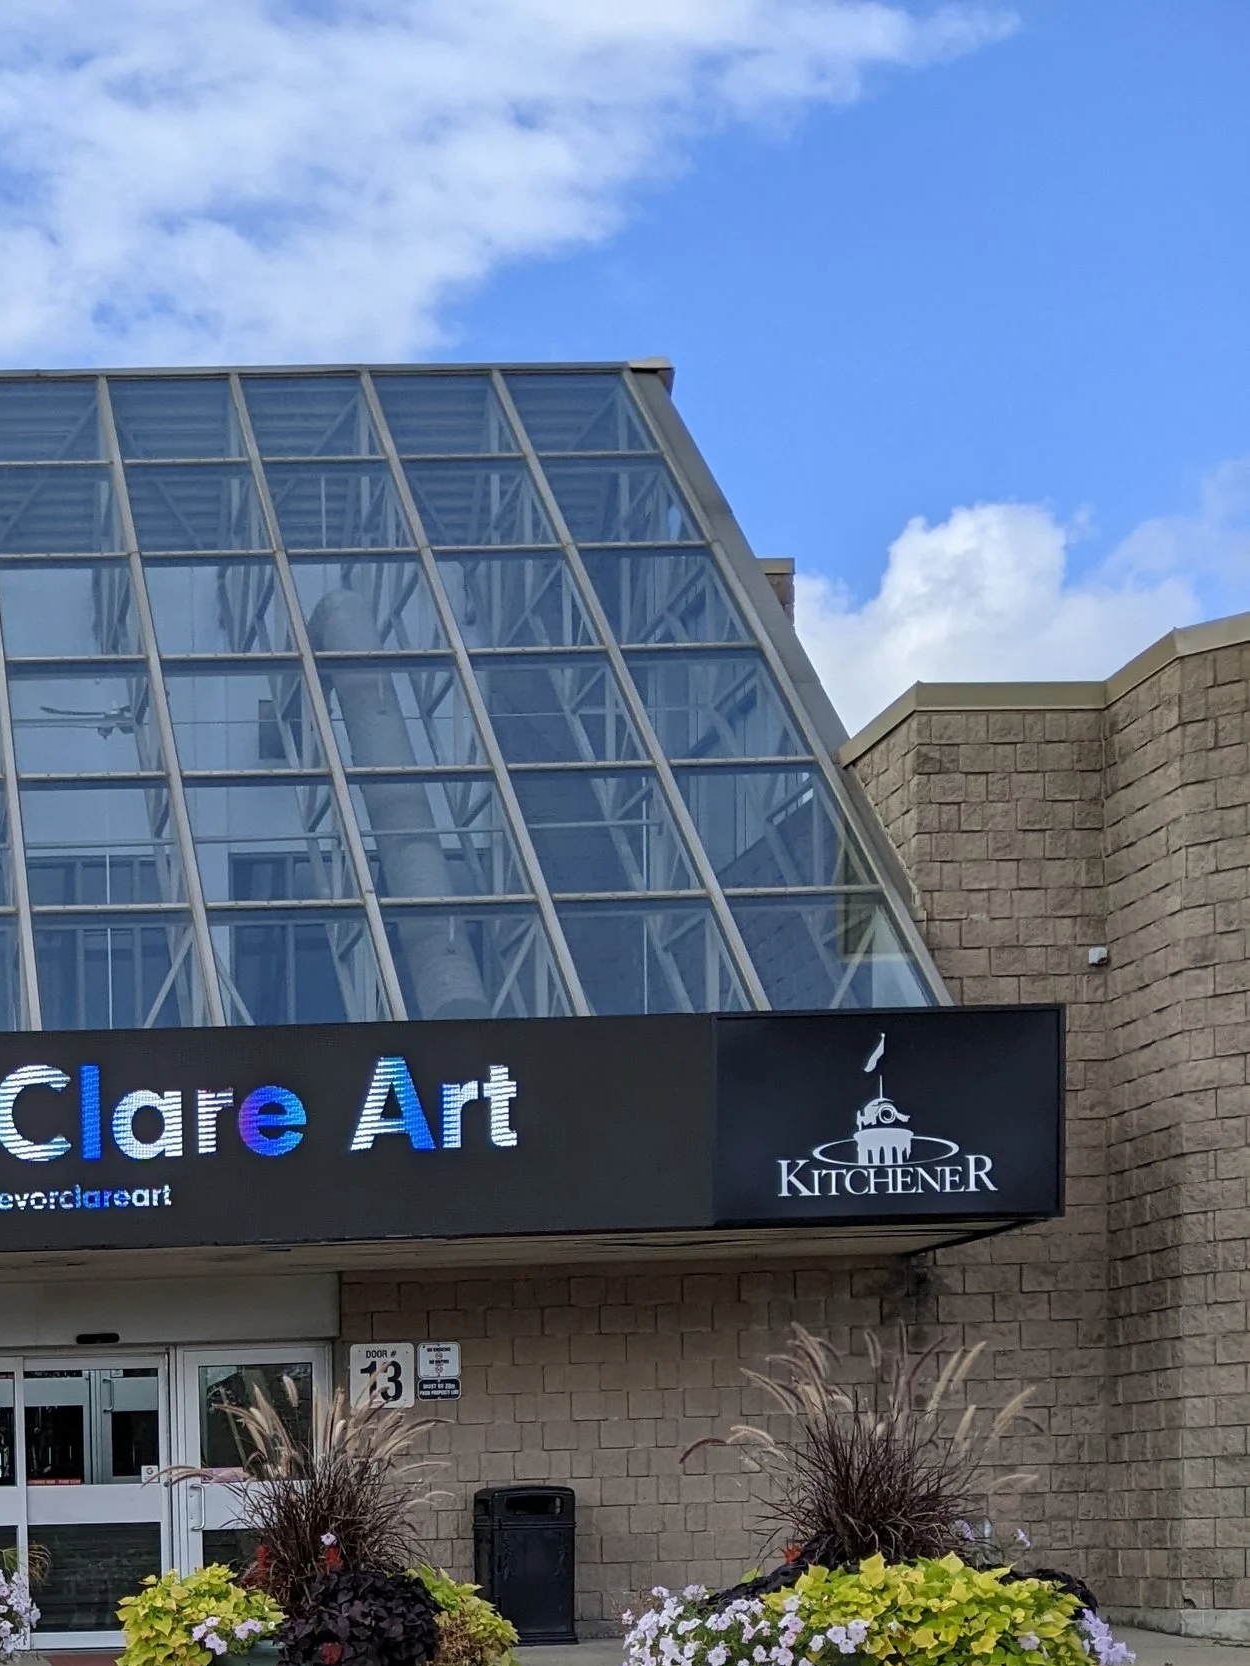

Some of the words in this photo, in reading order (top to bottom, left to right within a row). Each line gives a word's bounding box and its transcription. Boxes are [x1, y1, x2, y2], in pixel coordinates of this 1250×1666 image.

[350, 1055, 519, 1152] Art
[777, 1155, 999, 1197] KITCHENER
[365, 1349, 388, 1359] DOOR
[390, 1350, 397, 1358] #
[360, 1360, 403, 1402] 13
